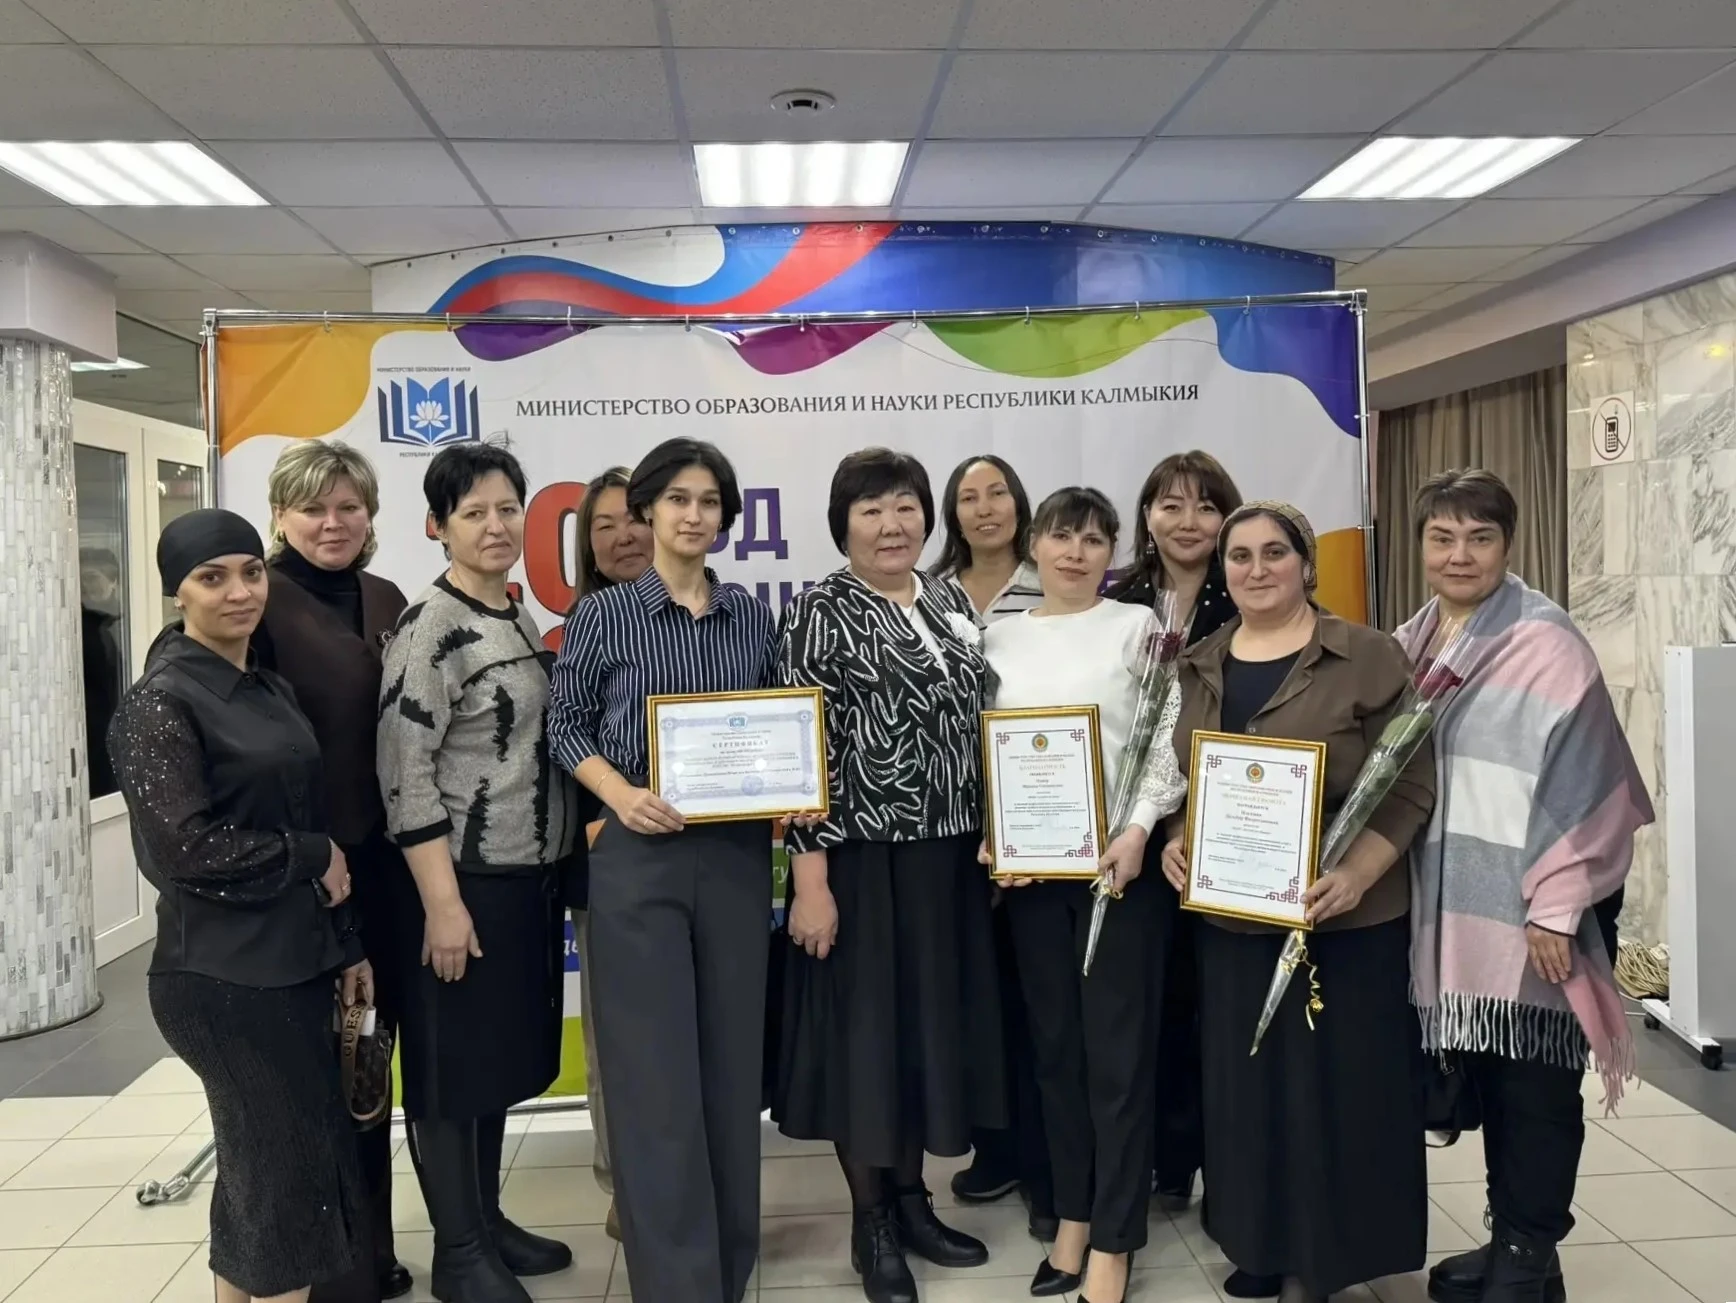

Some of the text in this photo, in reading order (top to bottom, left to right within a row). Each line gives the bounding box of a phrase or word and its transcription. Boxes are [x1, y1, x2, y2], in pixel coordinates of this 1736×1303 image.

[516, 384, 1199, 417] МИНИСТЕРСТВО ОБРАЗОВАНИЯ И НАУКИ РЕСПУБЛИКИ КАЛМЫКИЯ
